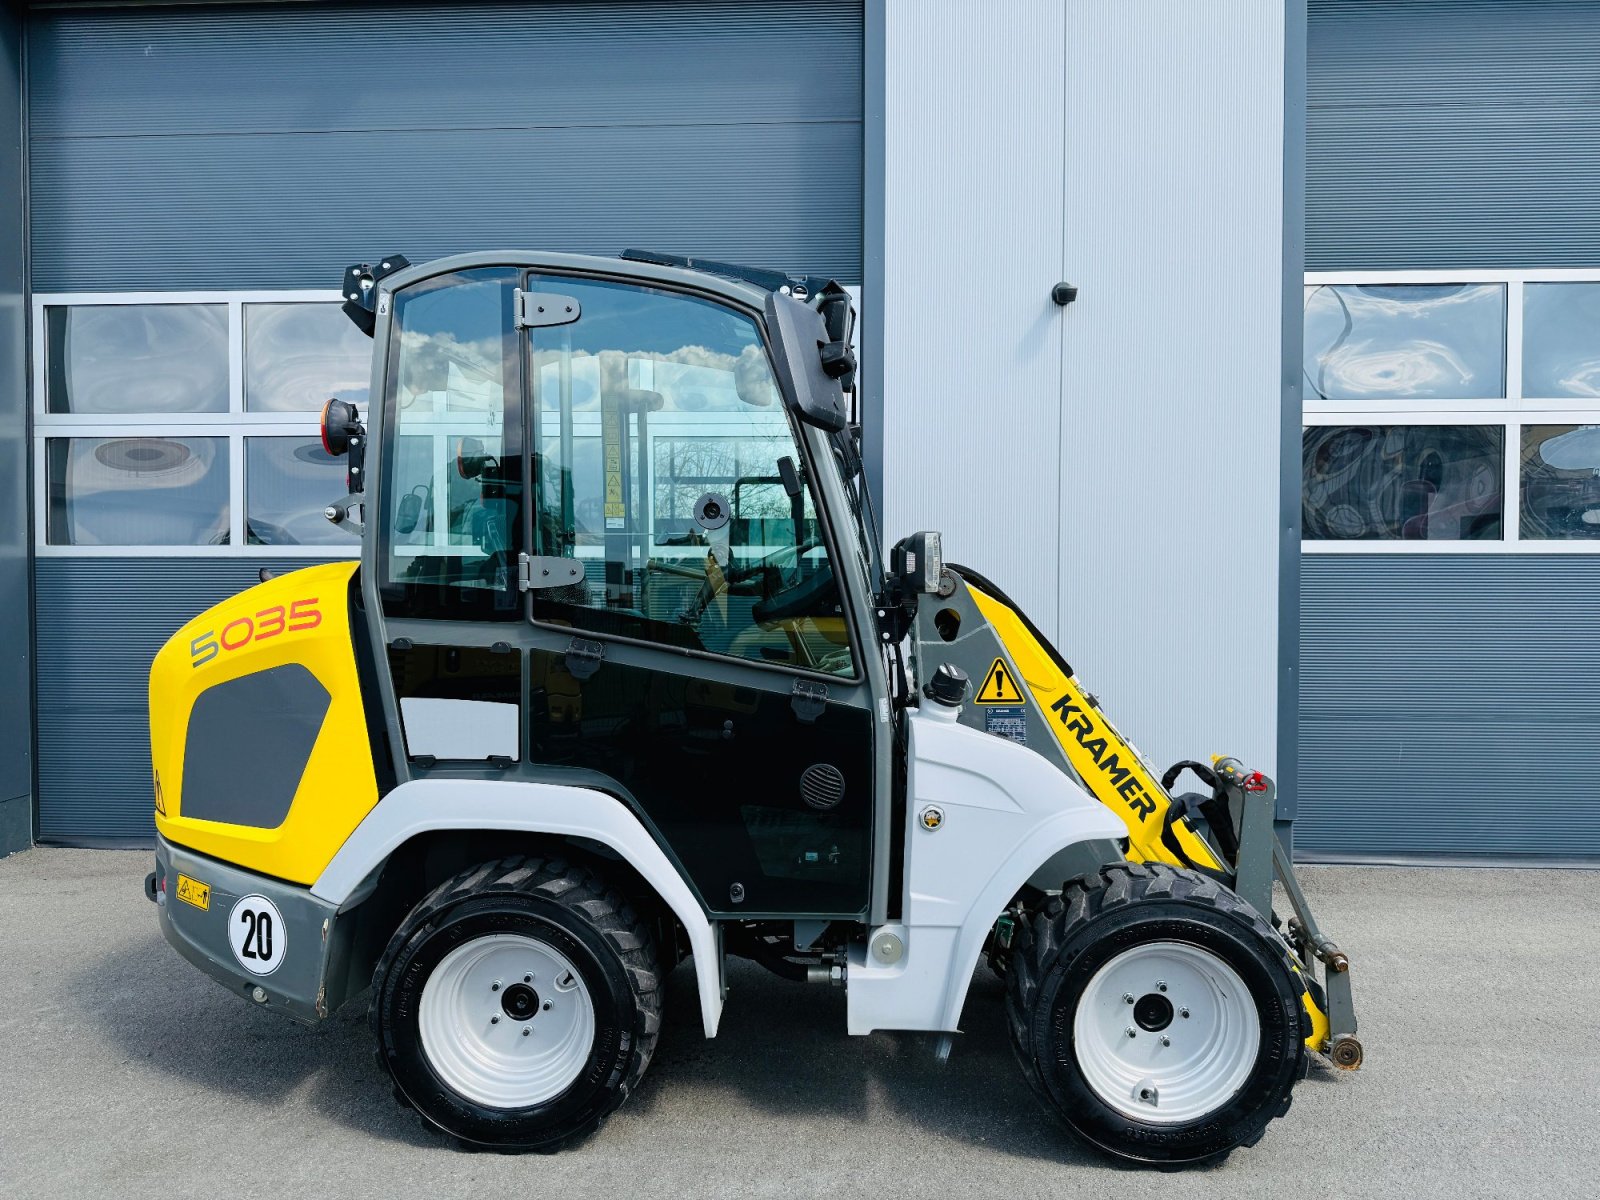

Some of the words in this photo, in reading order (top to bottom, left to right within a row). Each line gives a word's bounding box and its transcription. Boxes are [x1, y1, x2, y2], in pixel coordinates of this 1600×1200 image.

[190, 598, 322, 669] 5035
[1050, 693, 1157, 824] KRAMER
[241, 909, 273, 962] 20
